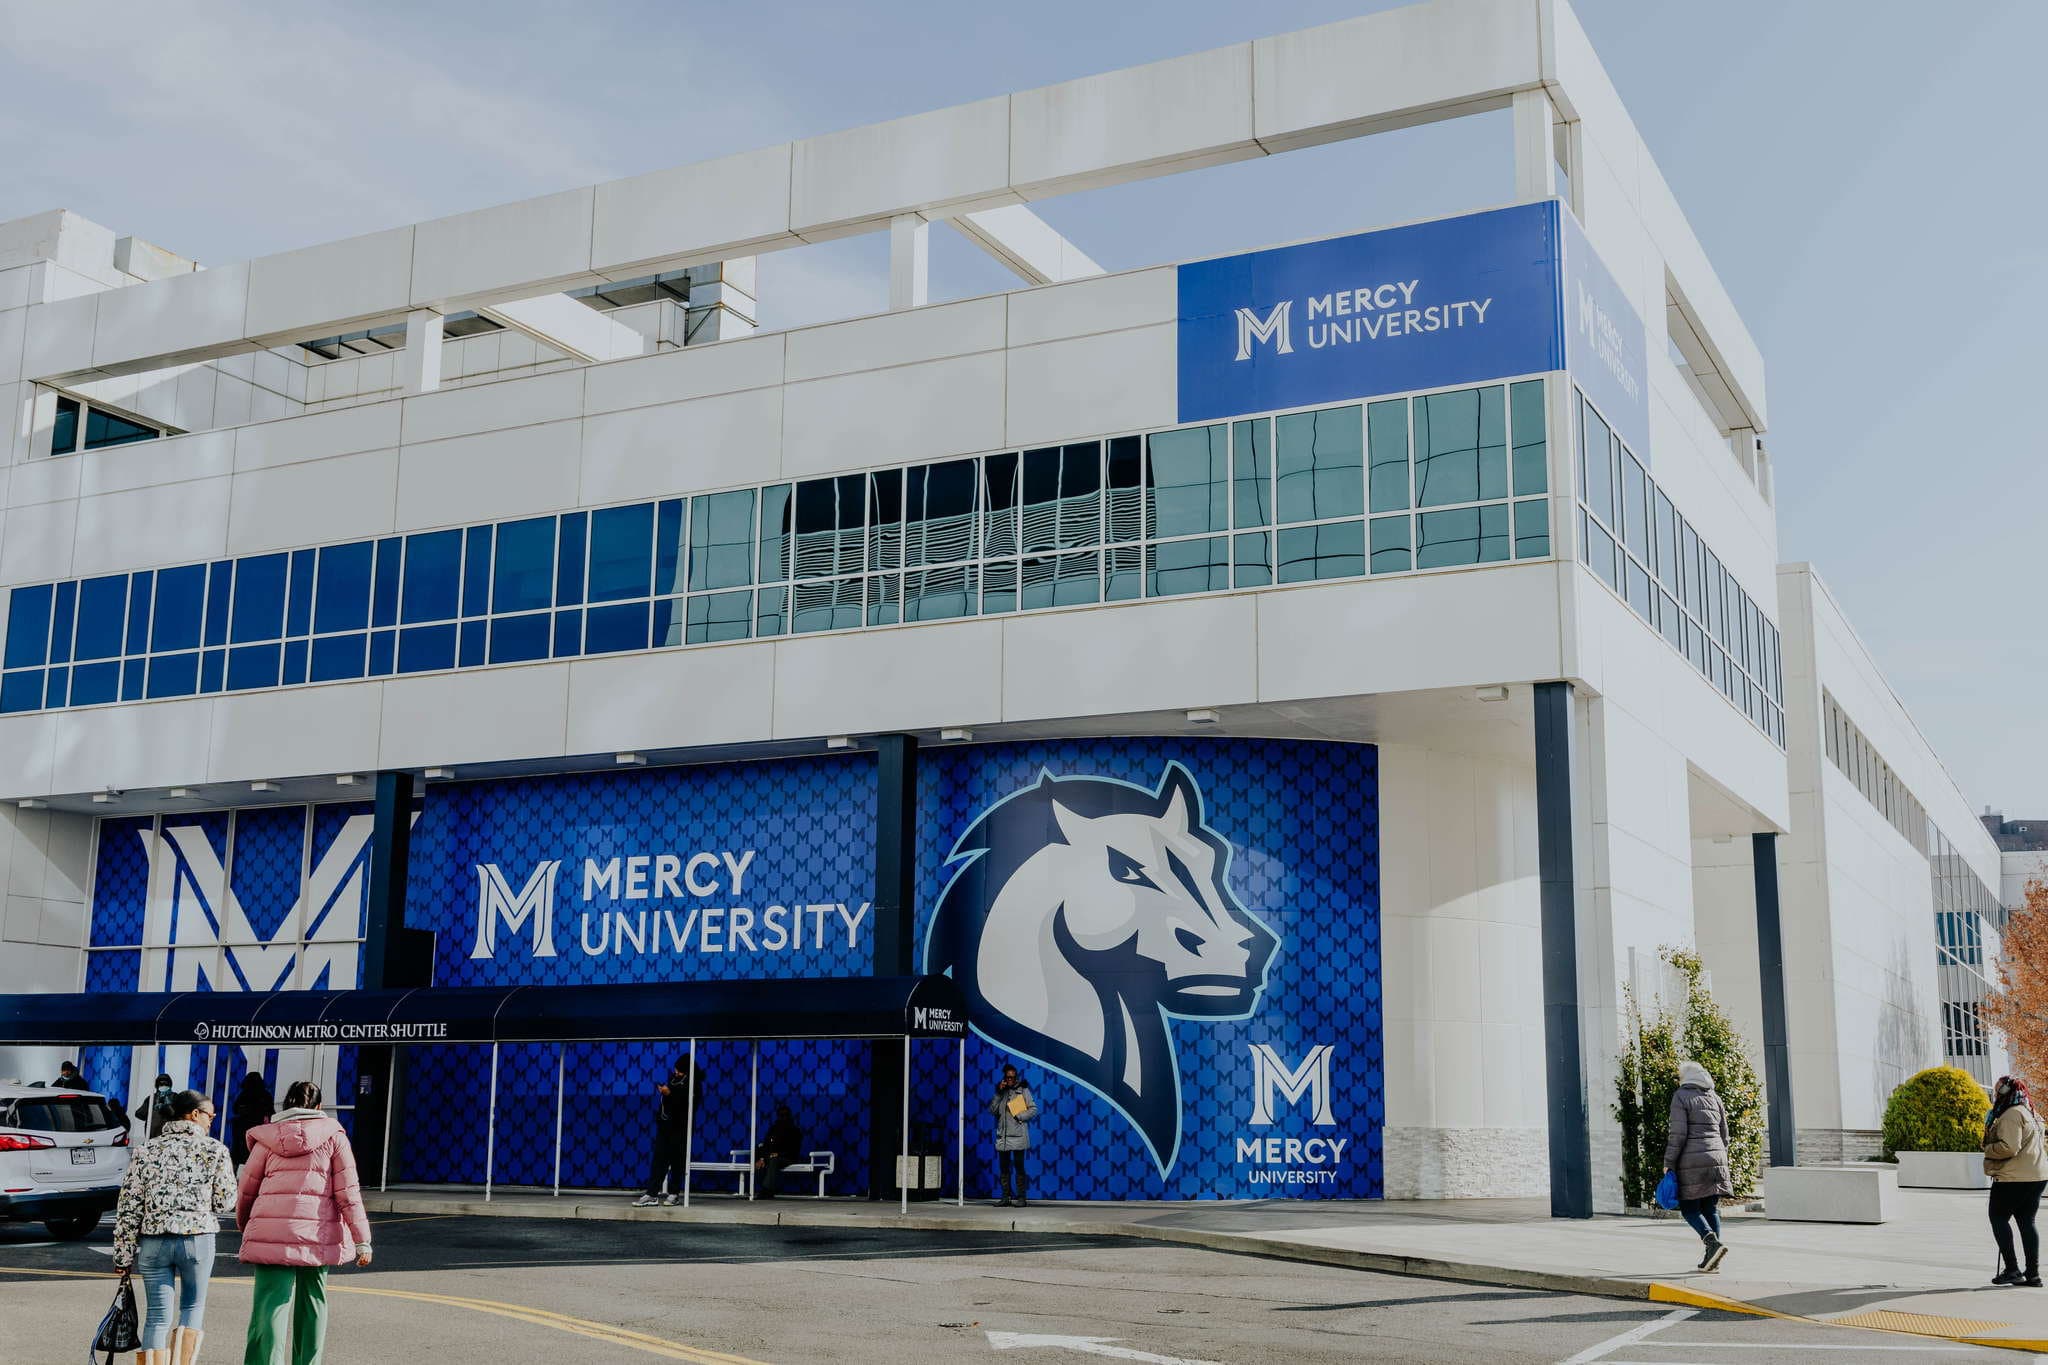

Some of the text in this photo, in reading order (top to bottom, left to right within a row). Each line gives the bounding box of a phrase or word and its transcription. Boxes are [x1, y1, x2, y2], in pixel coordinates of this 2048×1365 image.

[1308, 280, 1419, 320] MERCY
[1234, 301, 1294, 361] M
[1308, 298, 1492, 349] UNIVERSITY
[583, 850, 756, 901] MERCY
[470, 860, 562, 959] M
[581, 902, 871, 956] UNIVERSITY
[212, 1023, 447, 1039] HUTCHINSON METRO CENTER SHUTTLE
[914, 1006, 927, 1029] M
[929, 1007, 951, 1019] MERCY
[929, 1020, 963, 1032] UNIVERSITY
[1248, 1044, 1337, 1125] M
[1236, 1138, 1347, 1164] MERCY
[1248, 1170, 1337, 1184] UNIVERSITY
